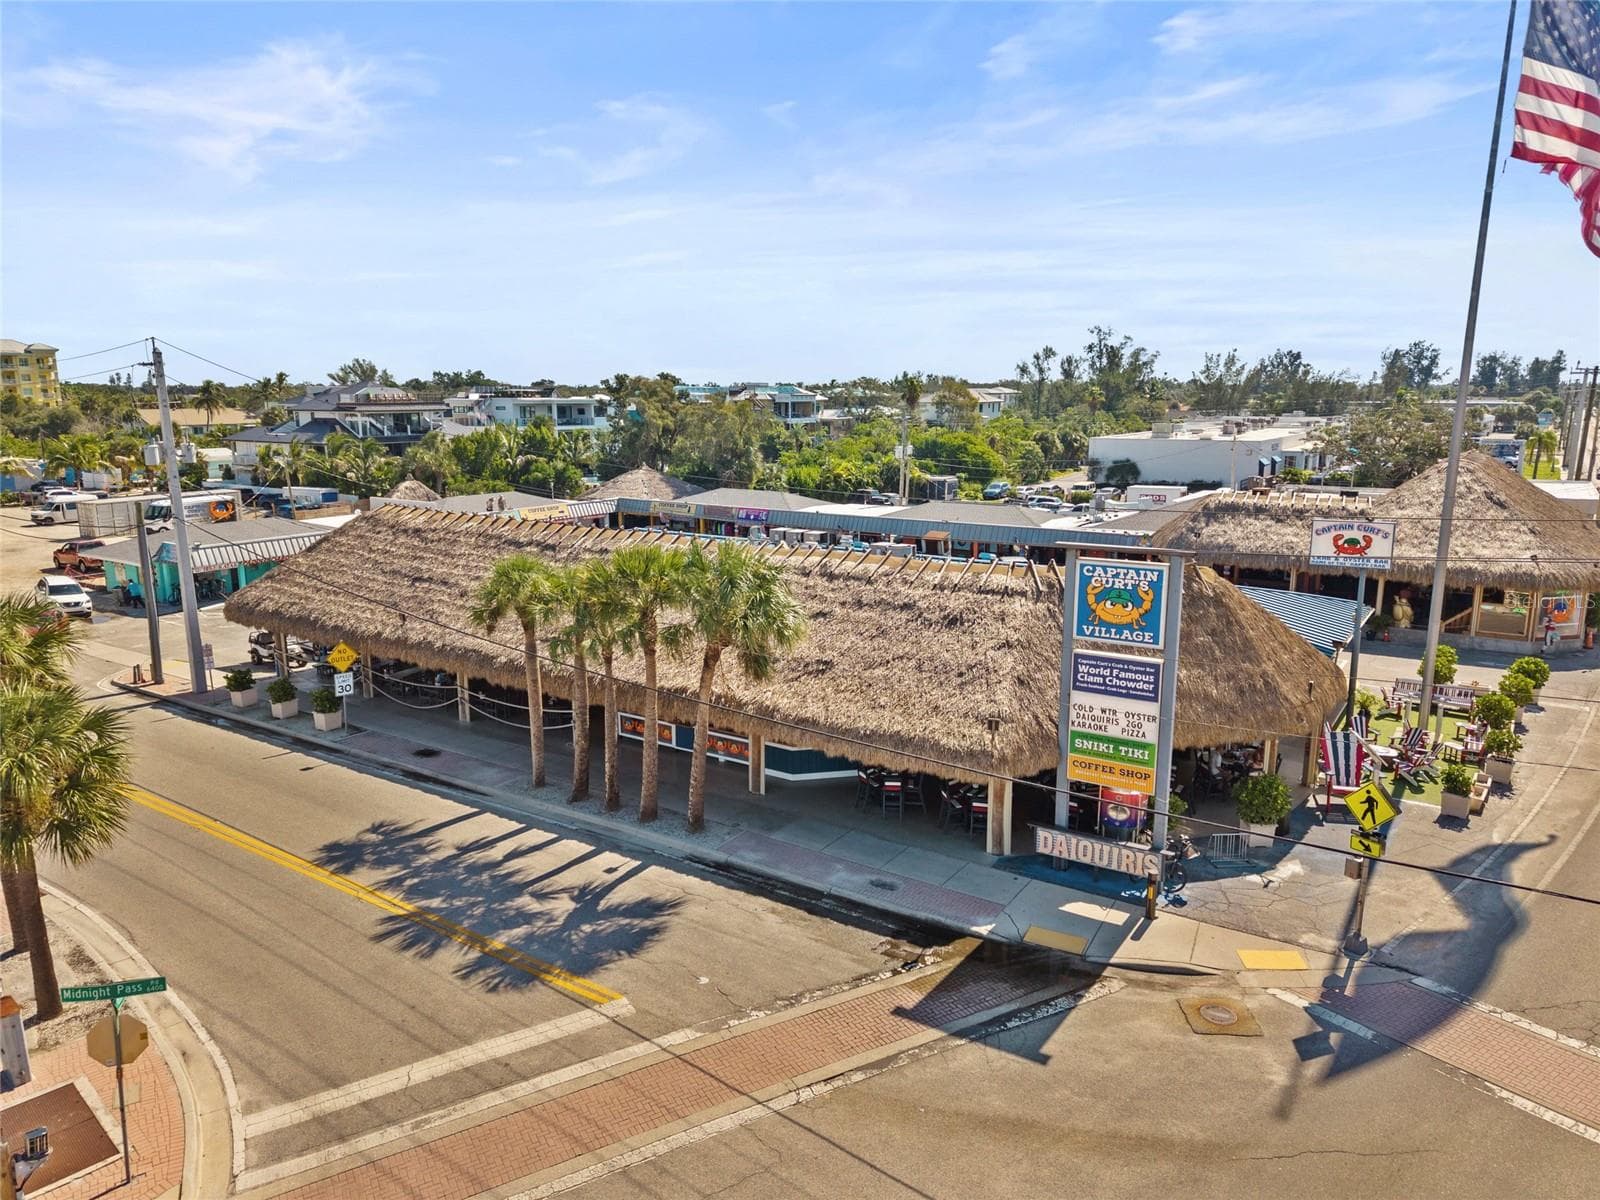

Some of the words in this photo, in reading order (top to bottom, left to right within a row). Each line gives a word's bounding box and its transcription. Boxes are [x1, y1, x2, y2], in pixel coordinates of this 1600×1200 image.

[1315, 524, 1354, 536] CAPTAIN
[1356, 524, 1390, 539] CURT'S
[1082, 565, 1159, 582] CAPTAIN
[1091, 577, 1150, 592] CURT'S
[1082, 625, 1154, 642] VILLAGE
[330, 655, 354, 664] OUTLET
[1077, 672, 1104, 684] Clam
[1106, 677, 1155, 691] Chowder
[1078, 664, 1111, 676] World
[1112, 668, 1155, 682] Famous
[338, 684, 352, 694] 30
[1072, 702, 1094, 713] COLD
[1100, 706, 1118, 716] WTR
[1124, 711, 1158, 724] OYSTER
[1076, 712, 1120, 726] DAIQUIRIS
[1126, 720, 1143, 730] 2GO
[1070, 720, 1108, 733] KARAOKE
[1121, 728, 1146, 739] PIZZA
[1074, 738, 1114, 754] SNIKI
[1119, 746, 1150, 760] TIKI
[1072, 760, 1116, 774] COFFEE
[1120, 768, 1151, 780] SHOP
[1038, 830, 1159, 876] DAIQUIRIS
[63, 987, 111, 1000] Midnight
[117, 984, 143, 994] Pass
